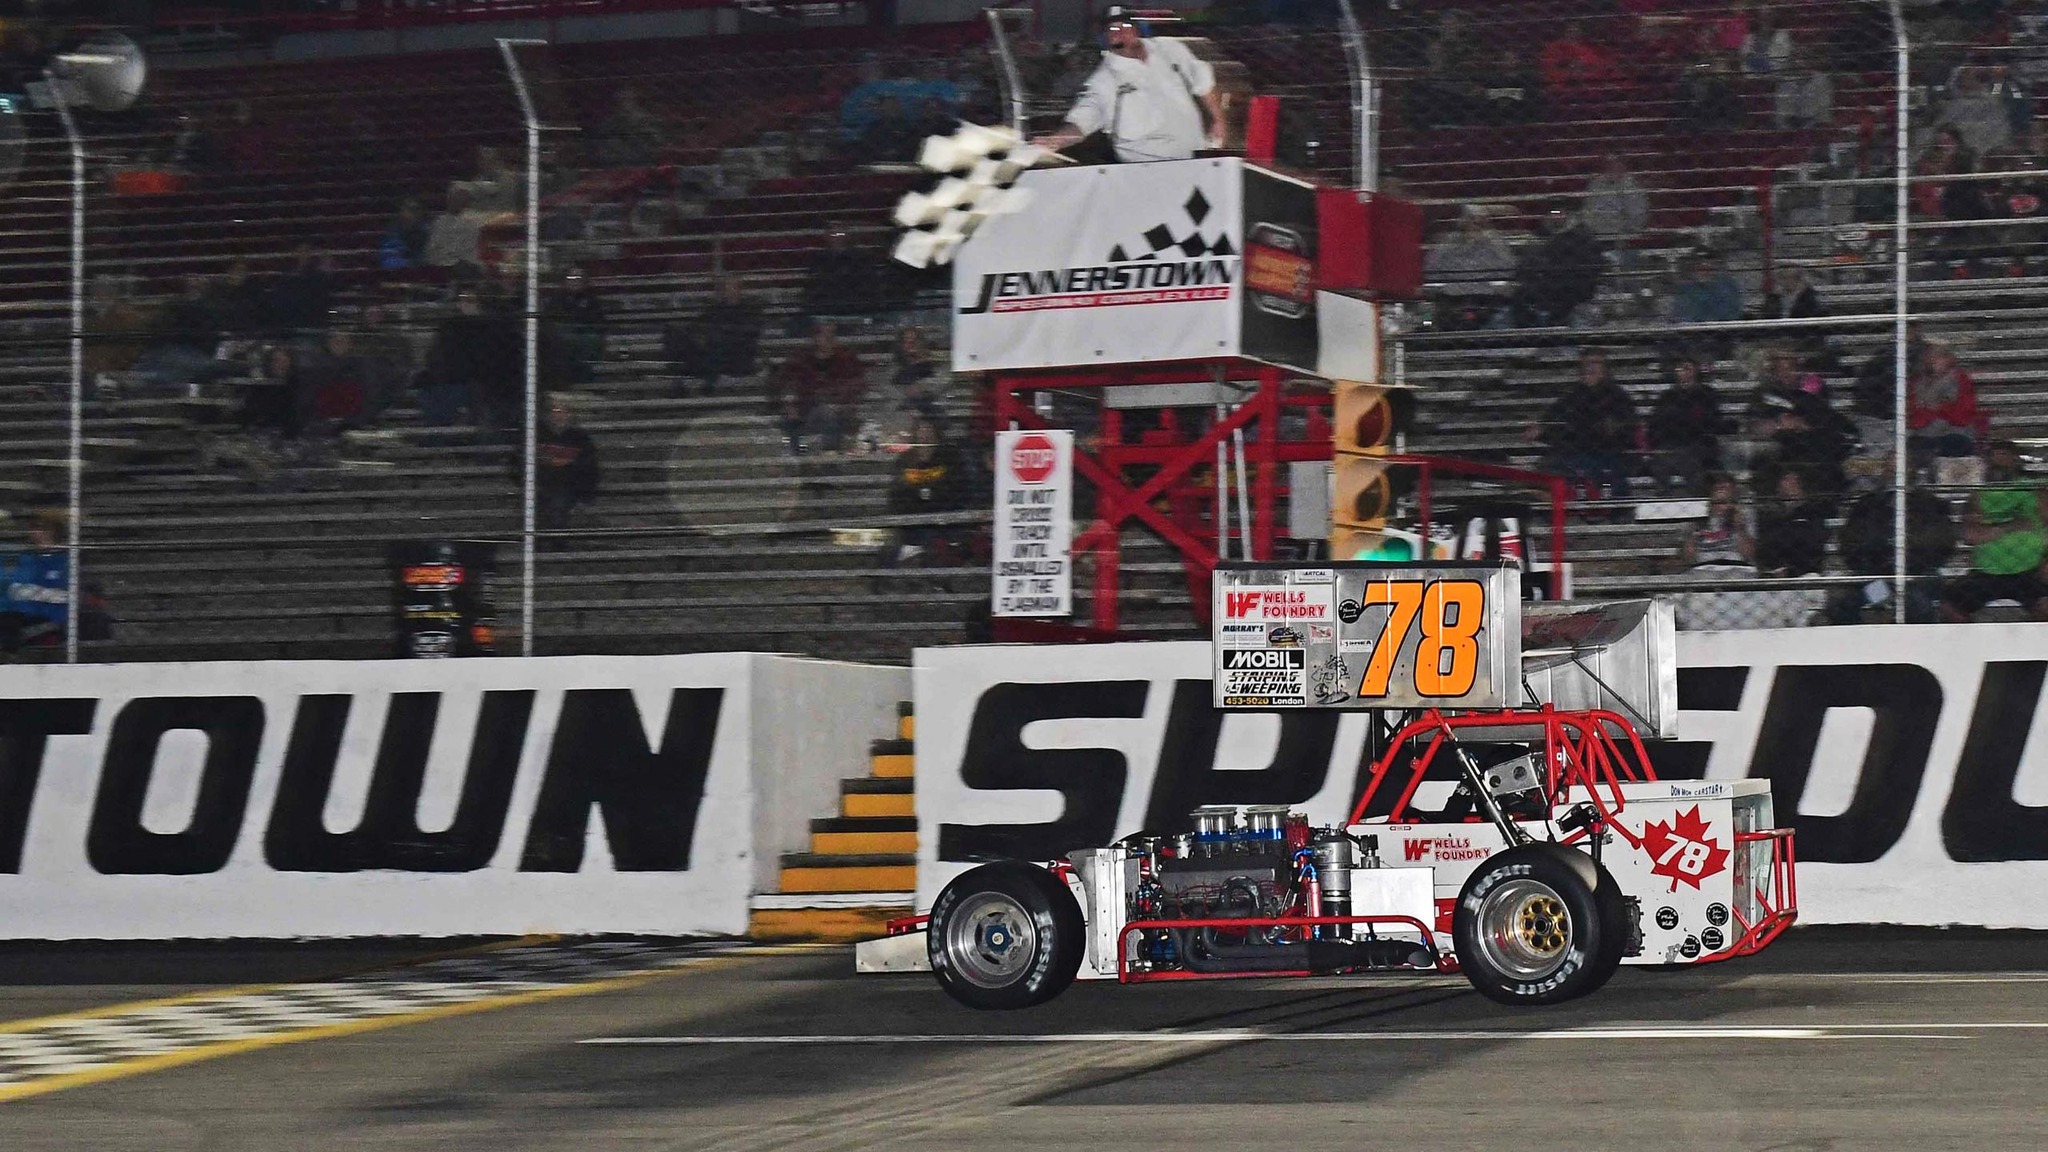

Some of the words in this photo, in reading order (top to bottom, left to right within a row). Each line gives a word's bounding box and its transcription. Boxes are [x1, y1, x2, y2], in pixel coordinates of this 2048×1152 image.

[959, 257, 1236, 315] JENNERSTOWN
[1012, 449, 1055, 470] STOP
[1263, 592, 1306, 603] WELLS
[1263, 606, 1327, 617] FOUNDRY
[1222, 625, 1265, 633] MURRAY'S
[1357, 579, 1485, 698] 78
[1228, 651, 1300, 668] MOBIL
[1229, 671, 1299, 683] STRIPING
[1230, 683, 1302, 694] SWEEPING
[1225, 696, 1270, 705] 453-5020
[1272, 696, 1303, 705] London
[1434, 838, 1470, 848] WELLS
[1405, 839, 1432, 860] WF
[1436, 849, 1490, 860] FOUNDRY
[1656, 833, 1711, 875] 78
